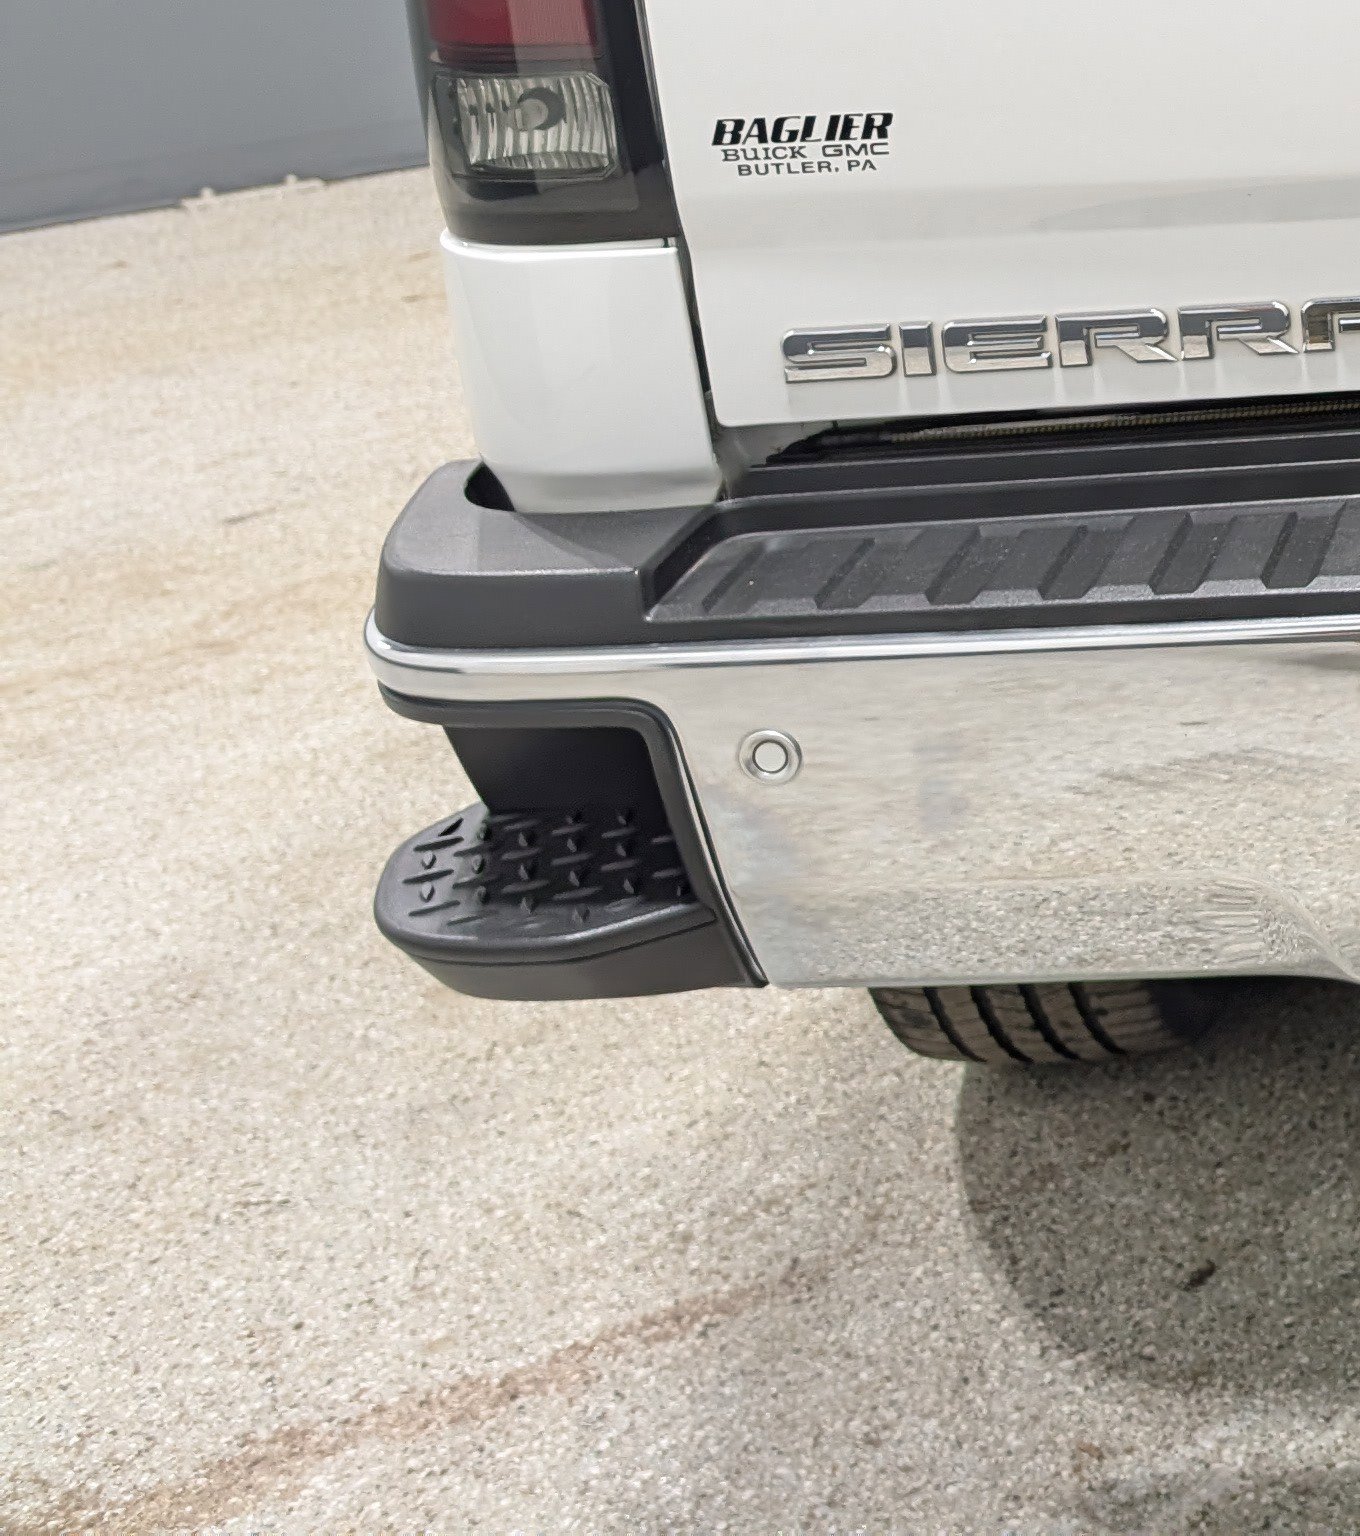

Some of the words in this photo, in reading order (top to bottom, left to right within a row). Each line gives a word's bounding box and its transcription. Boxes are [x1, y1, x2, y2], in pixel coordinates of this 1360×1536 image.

[712, 112, 894, 146] BAGLIER
[721, 145, 808, 162] BUICK
[821, 142, 890, 157] GMC
[847, 159, 877, 172] PA
